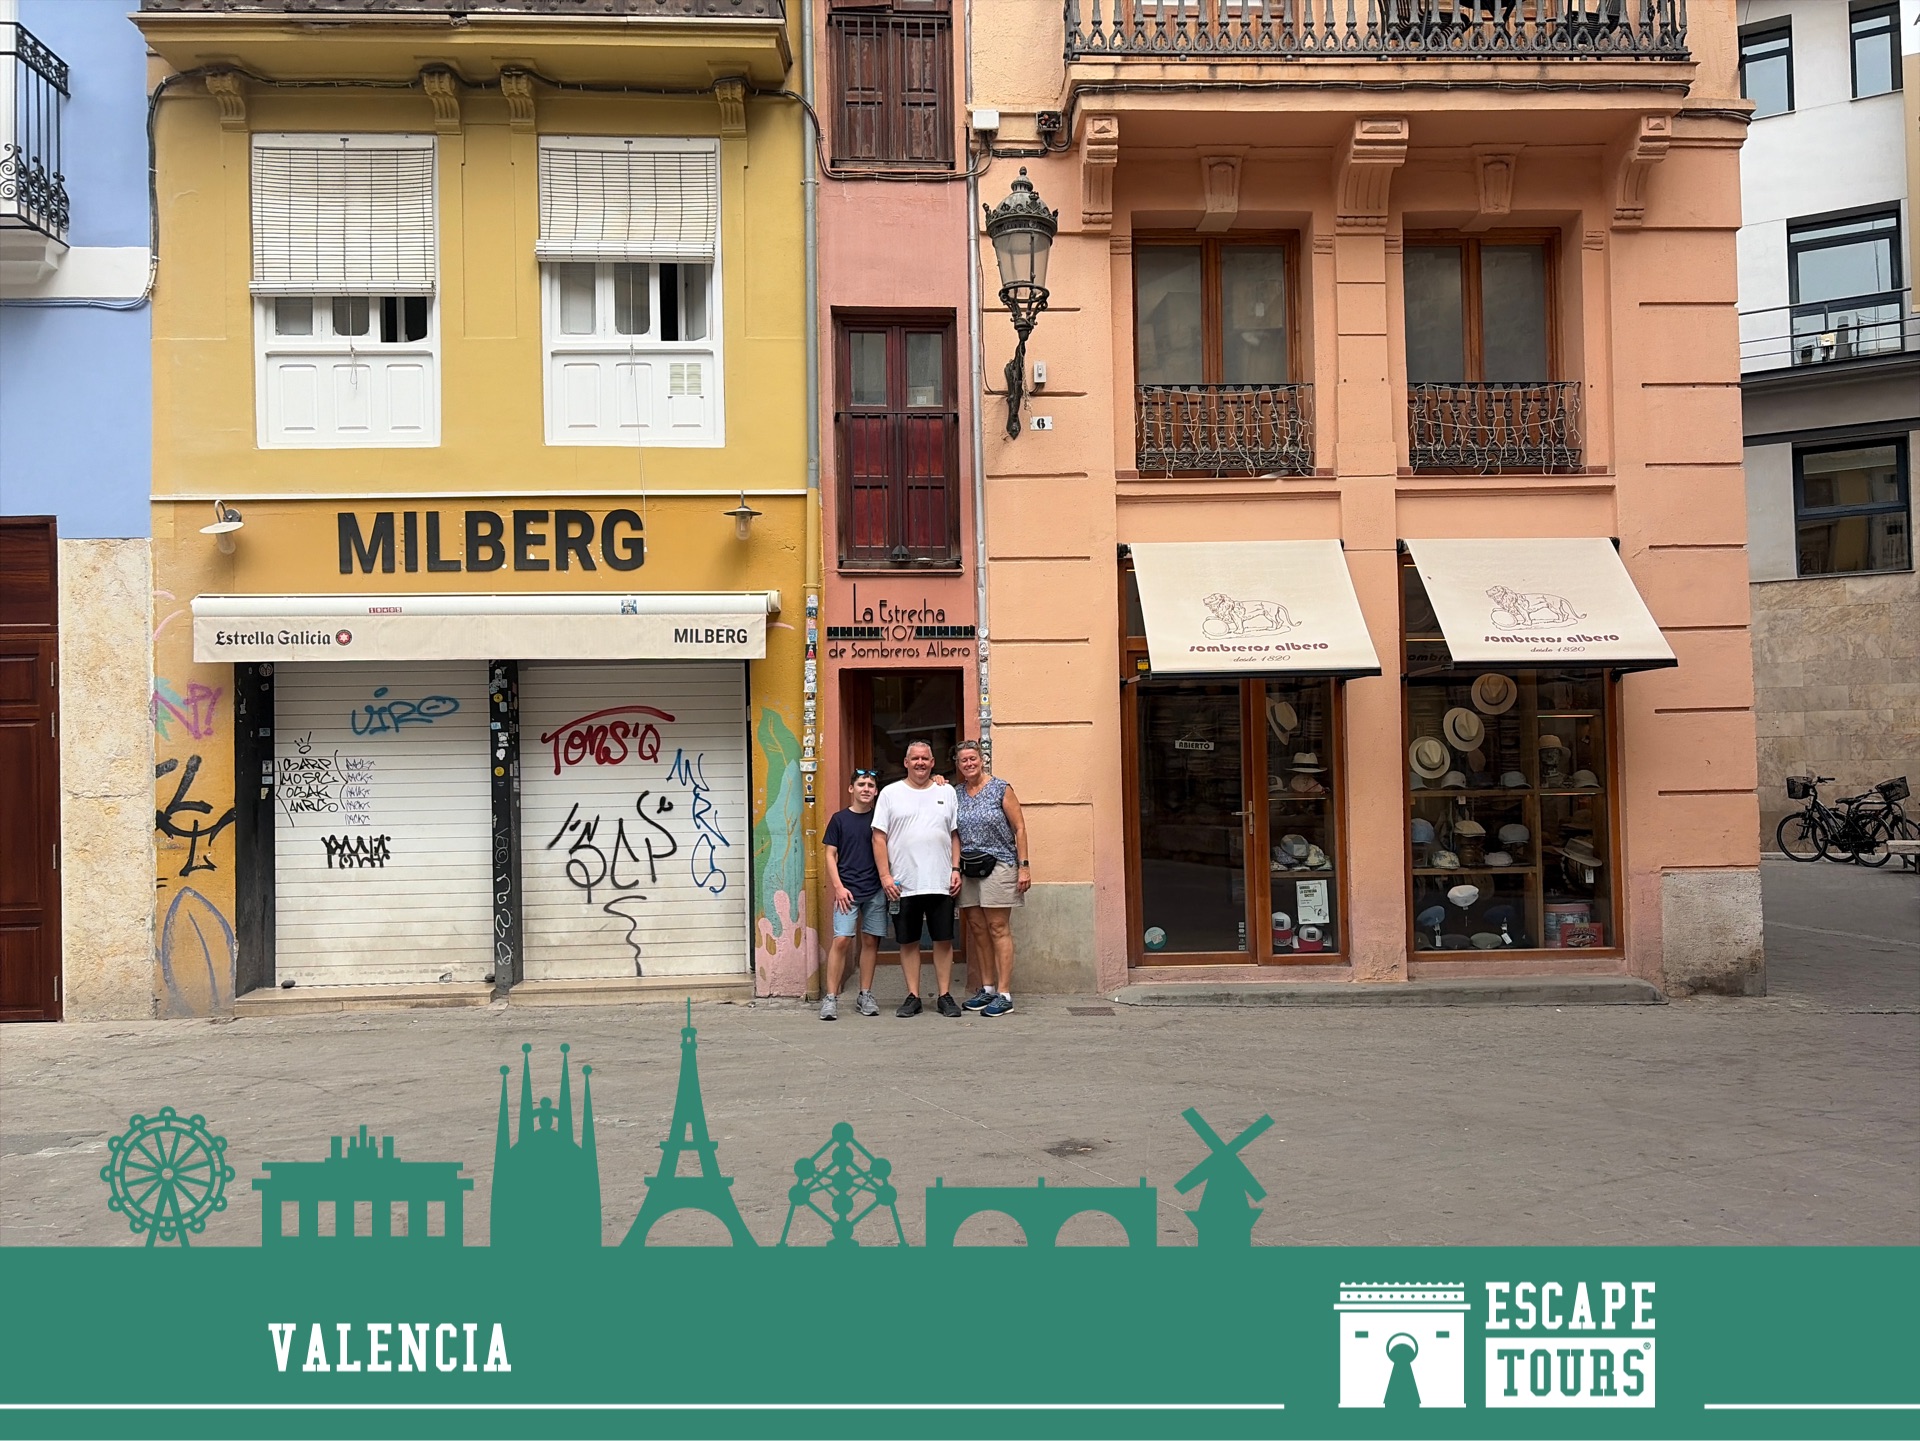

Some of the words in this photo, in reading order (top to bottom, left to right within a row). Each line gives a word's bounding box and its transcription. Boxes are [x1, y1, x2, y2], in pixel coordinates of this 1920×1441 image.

[1037, 418, 1045, 429] 6
[337, 509, 645, 574] MILBERG
[853, 583, 873, 623] La
[879, 598, 945, 623] Estrecha
[215, 630, 274, 645] Estrella
[278, 629, 331, 645] Galicia
[674, 628, 748, 644] MILBERG
[1484, 634, 1562, 643] sombreros
[1566, 633, 1620, 643] albero
[829, 642, 847, 658] de
[851, 641, 920, 658] Sombreros
[926, 641, 971, 658] Albero
[1189, 643, 1270, 653] sombreros
[1275, 642, 1329, 651] albero
[1261, 654, 1291, 662] 1820
[1179, 741, 1210, 750] ABIERTO
